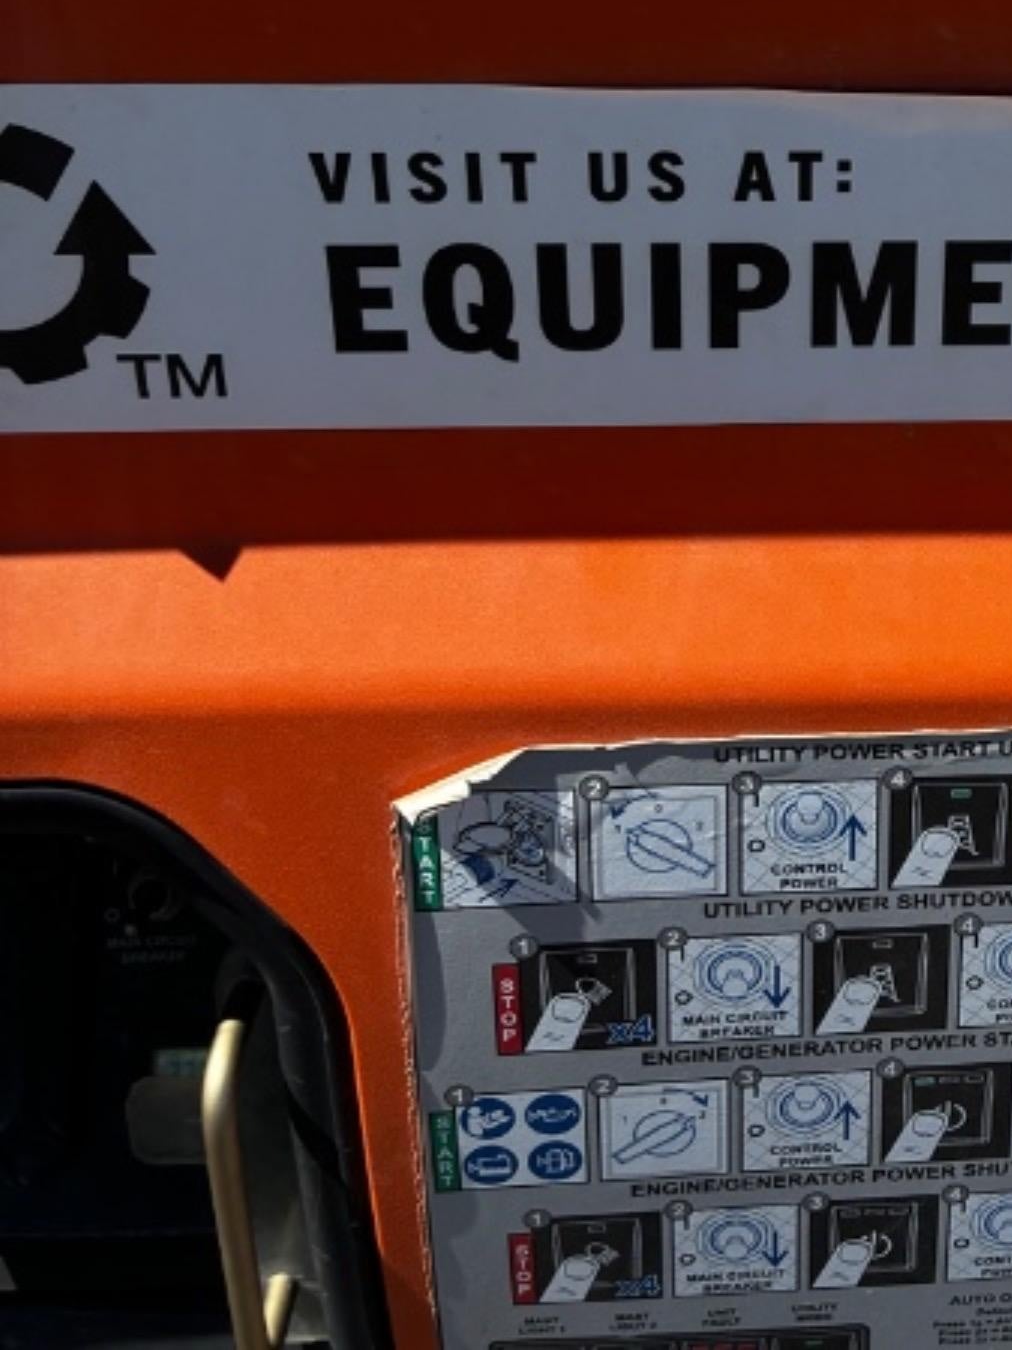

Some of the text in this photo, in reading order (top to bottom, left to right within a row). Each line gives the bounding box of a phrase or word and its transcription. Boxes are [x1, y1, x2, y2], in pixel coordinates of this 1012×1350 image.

[309, 150, 853, 203] VISIT US AT:
[117, 353, 228, 398] TM
[714, 746, 808, 763] UTILITY
[813, 743, 904, 762] POWER
[912, 741, 991, 759] START
[770, 863, 849, 876] CONTROL
[779, 878, 839, 889] POWER
[703, 900, 793, 919] UTILITY
[799, 896, 889, 914] POWER
[500, 977, 519, 1043] STOP
[682, 1009, 789, 1027] MAIN CIRCUIT
[700, 1026, 775, 1038] BREAKER
[641, 1037, 884, 1067] ENGINE/GENERATOR
[891, 1034, 977, 1052] POWER
[435, 1116, 452, 1188] START
[770, 1143, 842, 1155] CONTROL
[631, 1169, 865, 1197] ENGINE/GENERATOR
[872, 1164, 955, 1183] POWER
[515, 1244, 530, 1296] STOP
